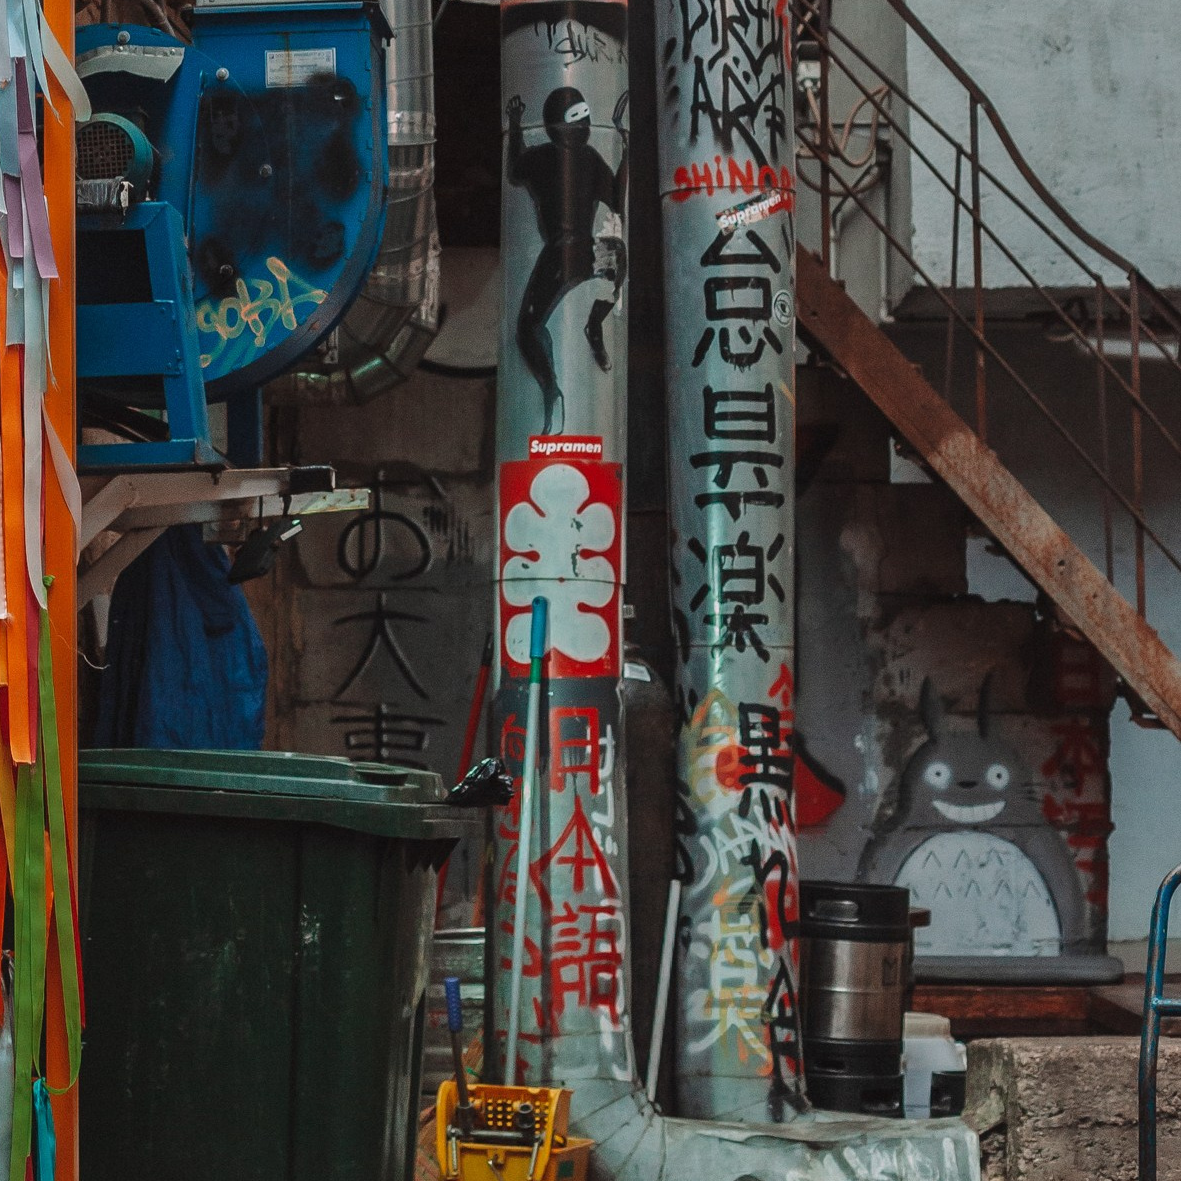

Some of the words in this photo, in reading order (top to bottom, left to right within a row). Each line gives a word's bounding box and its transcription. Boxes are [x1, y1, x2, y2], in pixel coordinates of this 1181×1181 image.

[719, 193, 782, 230] Supramen
[530, 439, 603, 467] Supramen
[530, 707, 623, 1029] 日本語
